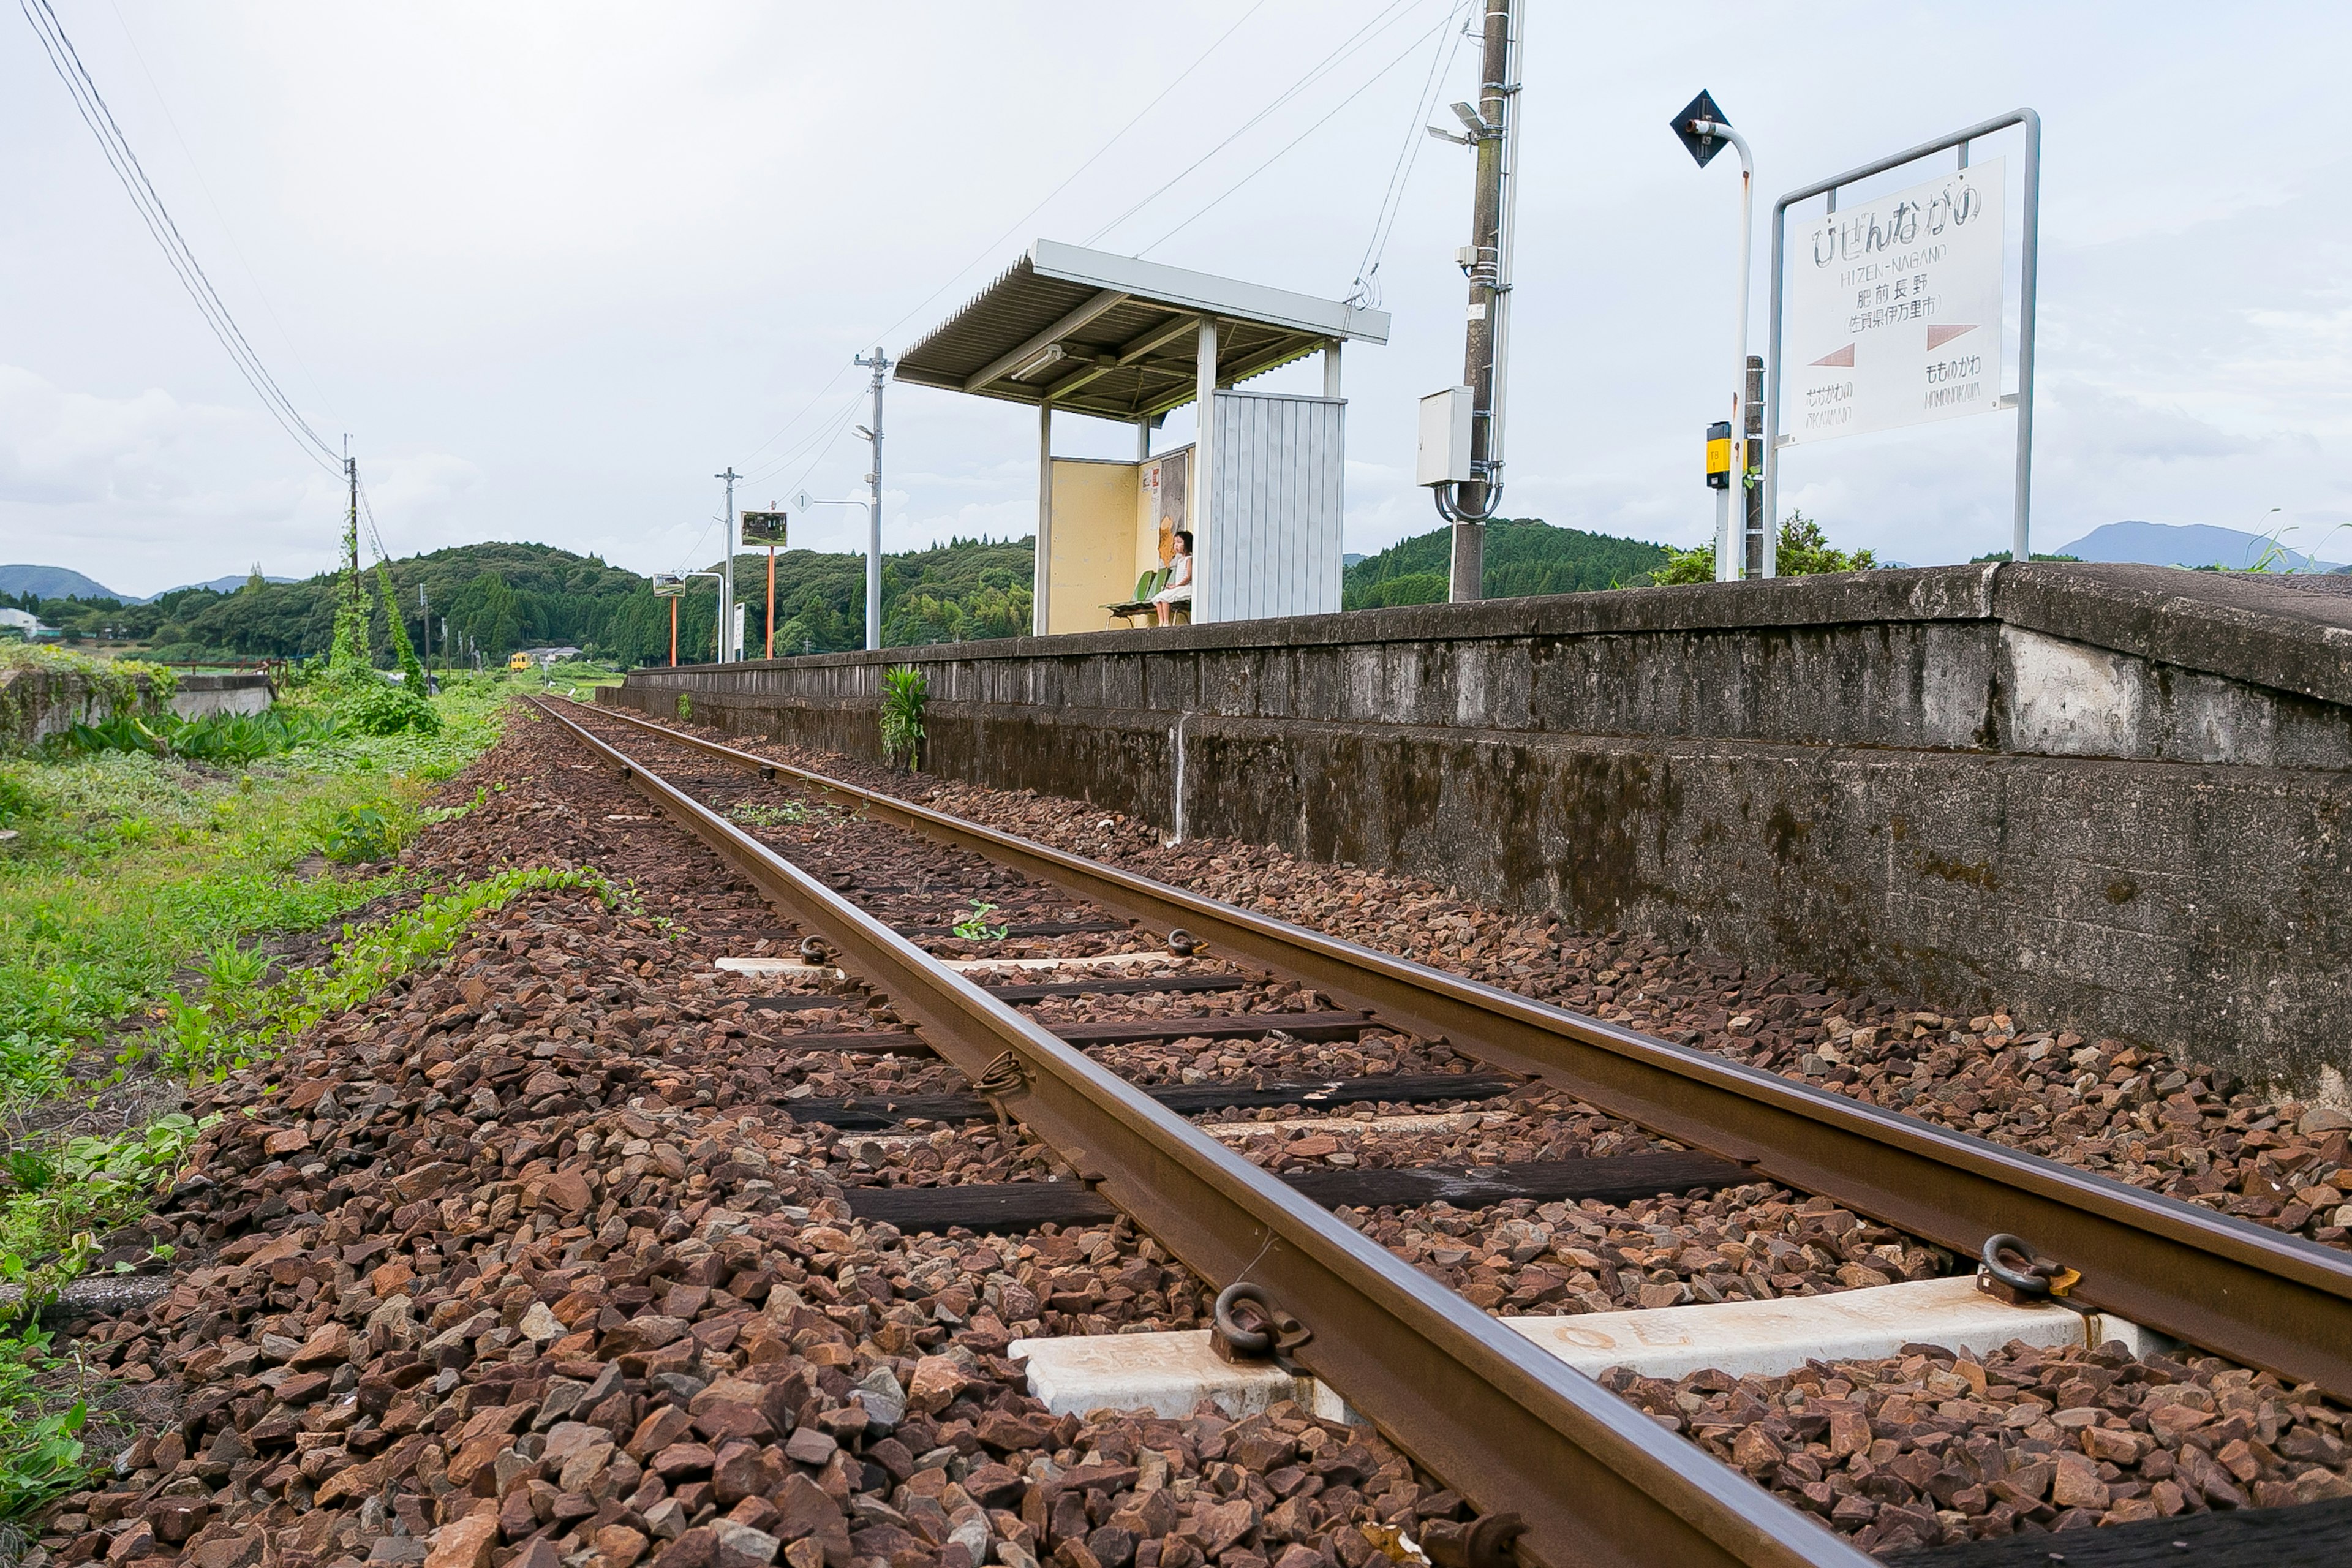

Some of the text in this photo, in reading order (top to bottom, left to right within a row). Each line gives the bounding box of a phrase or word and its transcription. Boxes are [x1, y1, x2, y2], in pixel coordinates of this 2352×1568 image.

[1811, 183, 1981, 268] ひぜんながの
[1841, 244, 1948, 288] HIZEN-NAGANO
[1856, 273, 1928, 309] 肥前長野
[1926, 355, 1981, 383] もものかわ
[1711, 450, 1719, 460] TB
[801, 495, 804, 507] 1
